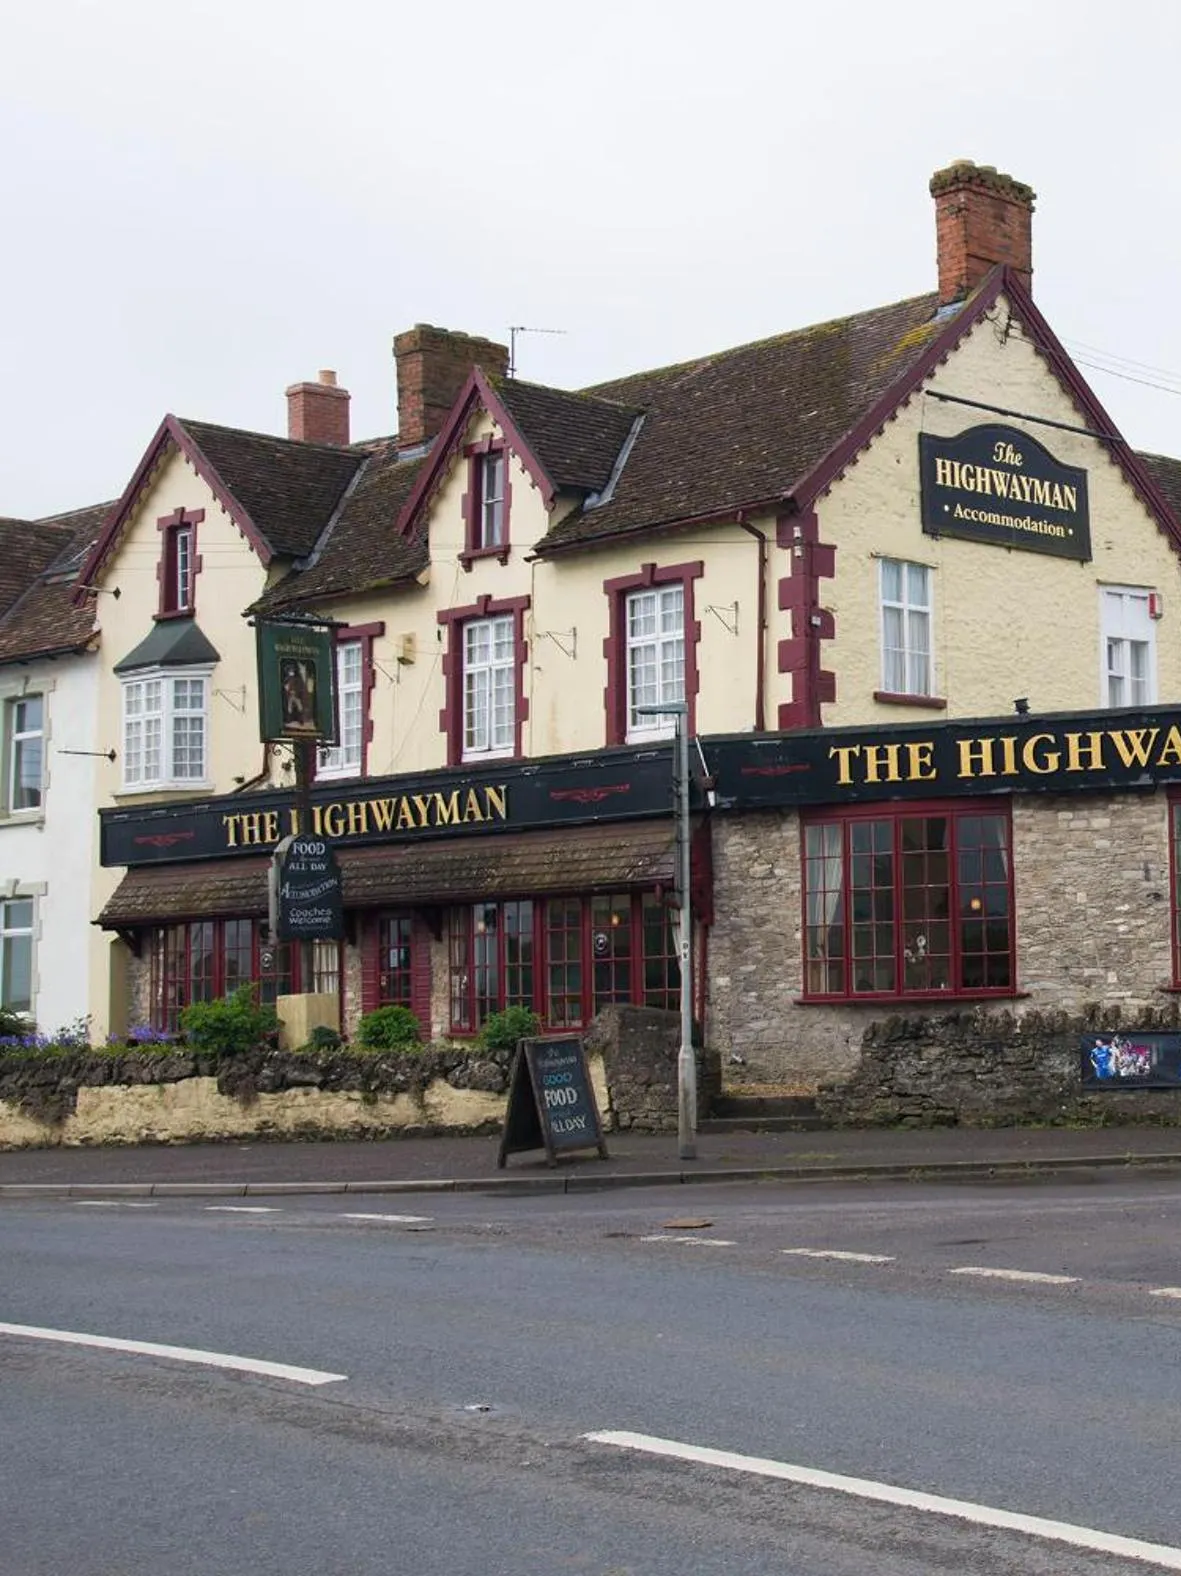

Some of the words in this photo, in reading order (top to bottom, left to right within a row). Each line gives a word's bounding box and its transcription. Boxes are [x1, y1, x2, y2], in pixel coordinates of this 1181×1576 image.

[992, 441, 1024, 467] The
[935, 457, 1077, 512] HIGHWAYMAN
[954, 503, 1066, 538] Accommodation
[829, 742, 937, 785] THE
[222, 810, 280, 847] THE
[292, 841, 326, 855] FOOD
[289, 861, 307, 871] ALL
[310, 862, 327, 871] DAY
[289, 907, 333, 918] Coaches
[544, 1087, 578, 1108] FOOD
